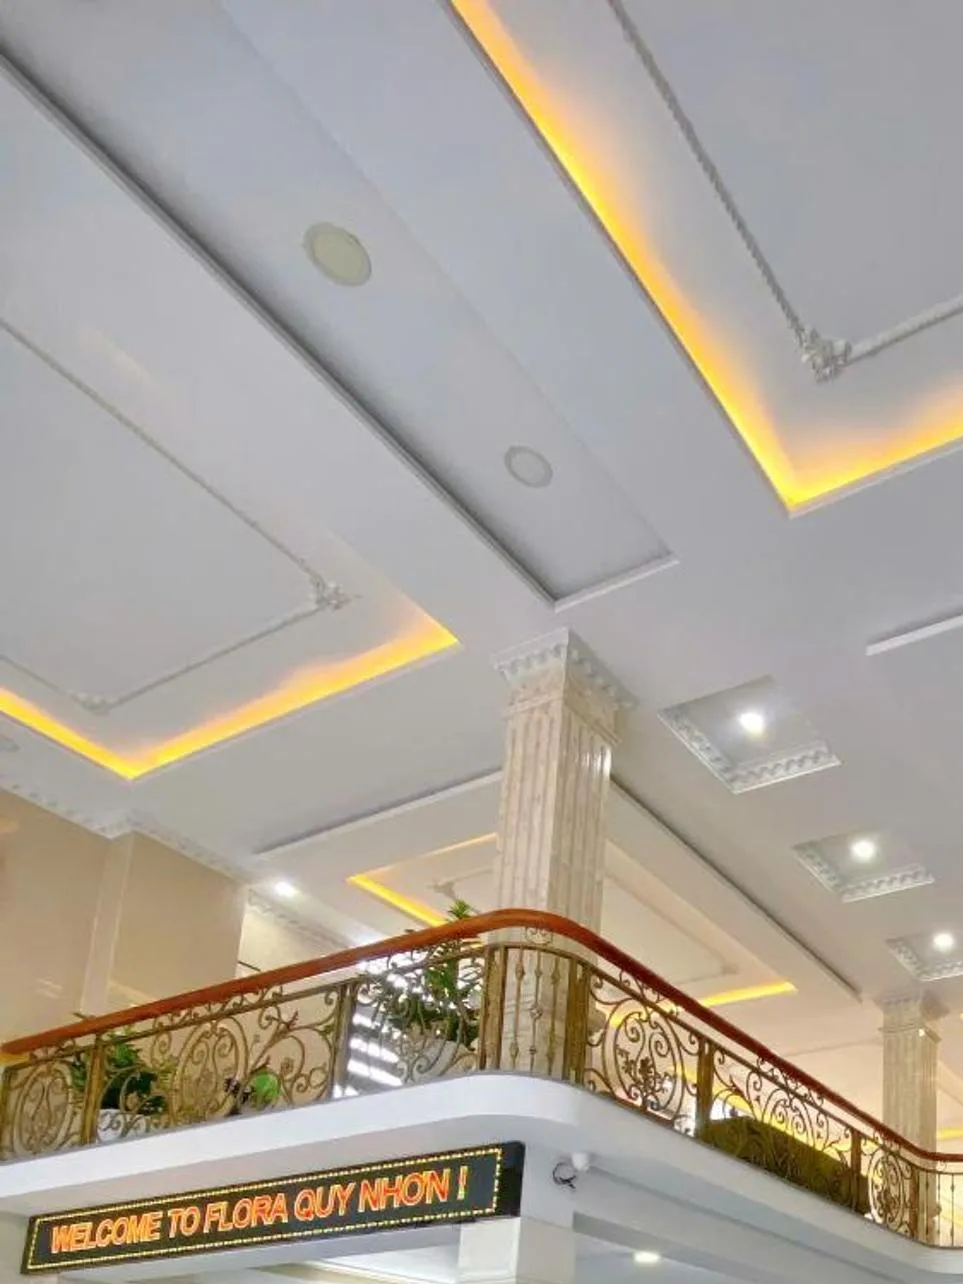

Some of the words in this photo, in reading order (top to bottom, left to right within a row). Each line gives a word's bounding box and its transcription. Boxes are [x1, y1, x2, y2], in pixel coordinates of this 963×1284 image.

[51, 1210, 163, 1254] WELCOME
[168, 1206, 199, 1239] TO
[203, 1193, 289, 1233] FLORA
[294, 1182, 356, 1222] QUY
